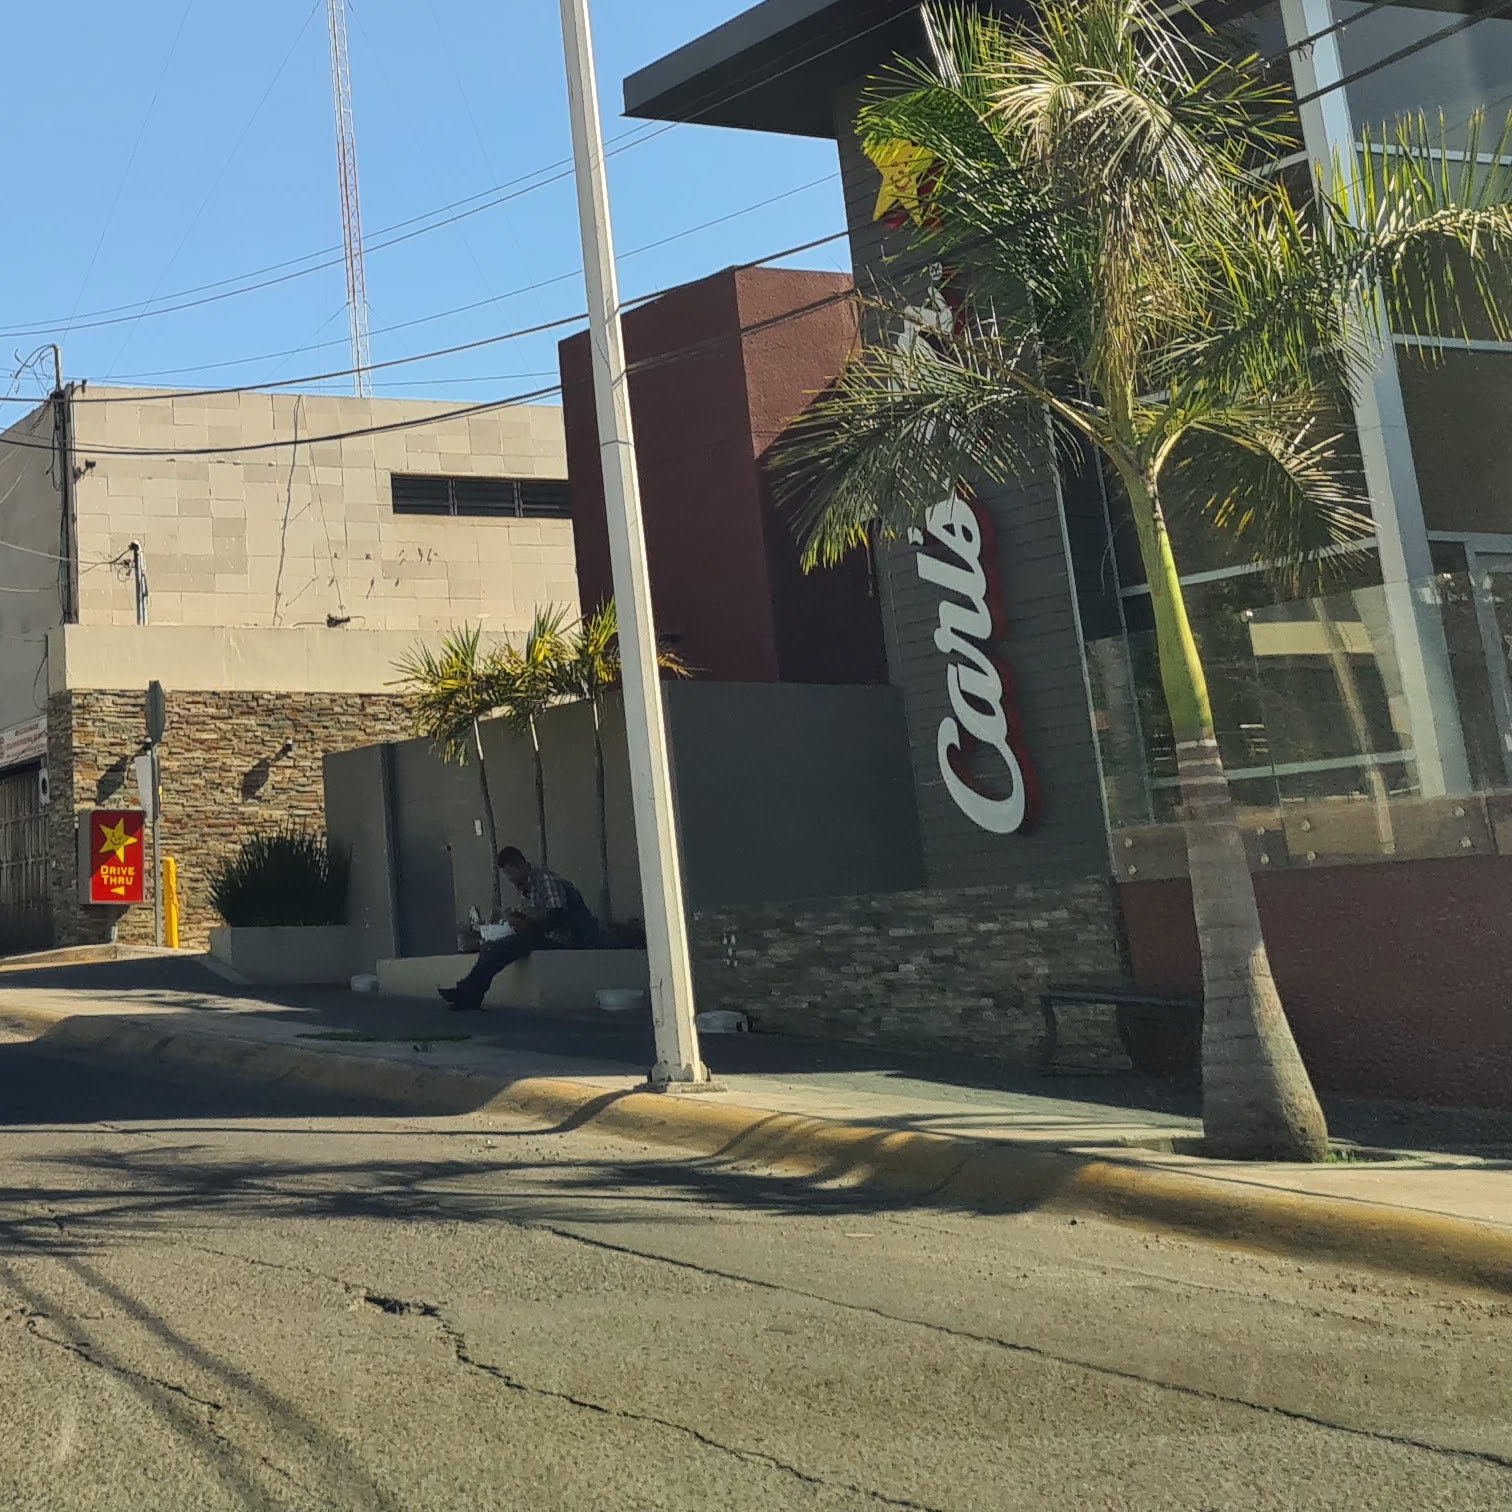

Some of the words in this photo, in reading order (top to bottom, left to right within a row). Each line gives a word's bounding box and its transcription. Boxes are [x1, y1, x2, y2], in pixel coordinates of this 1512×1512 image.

[907, 489, 1026, 835] Carl's
[100, 865, 135, 876] DRIVE
[101, 874, 134, 886] THRU
